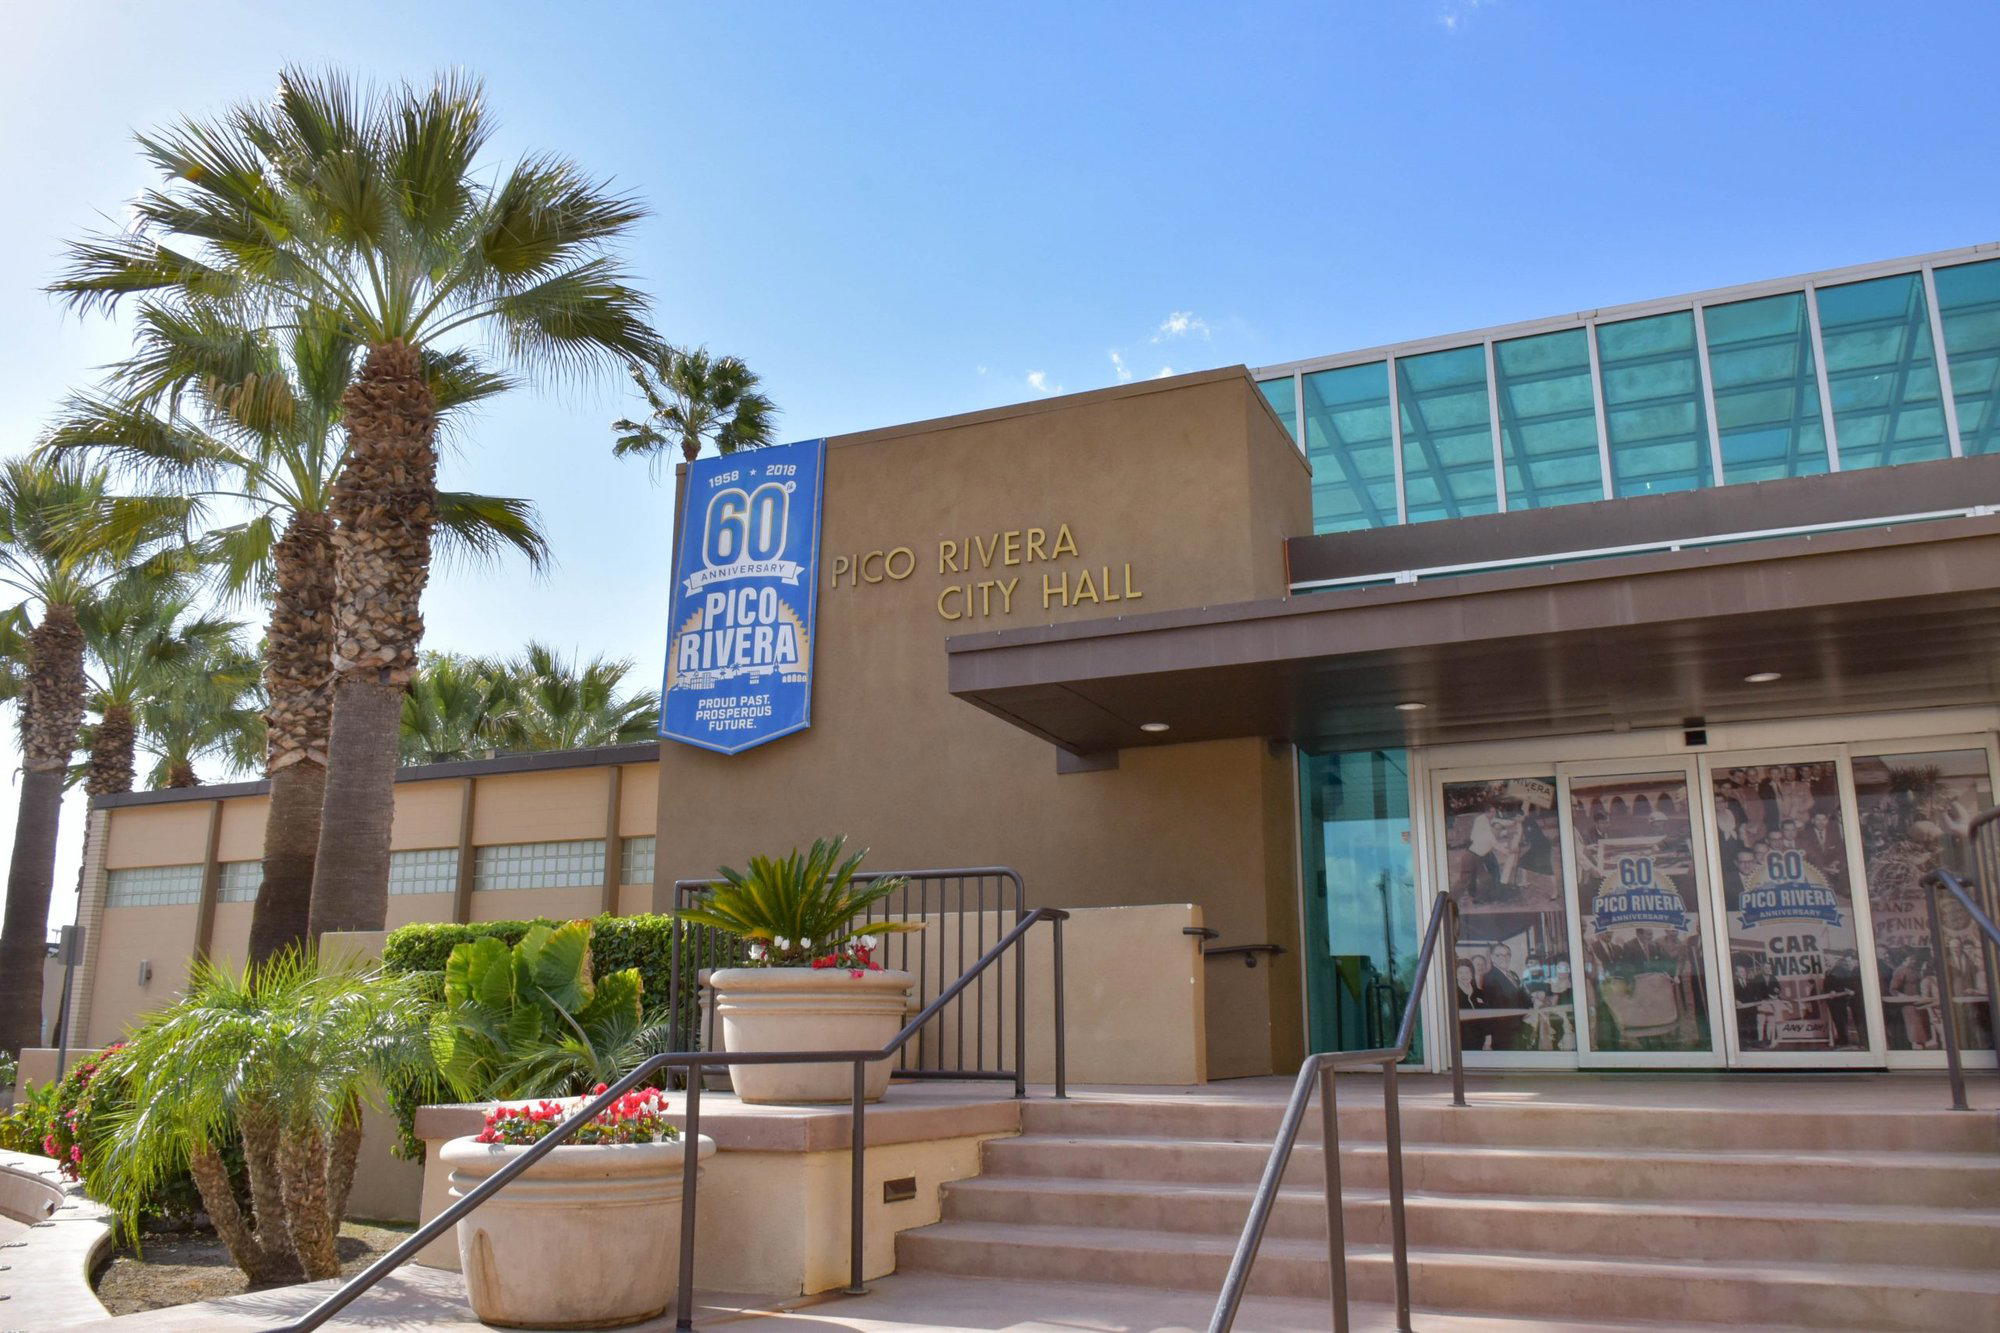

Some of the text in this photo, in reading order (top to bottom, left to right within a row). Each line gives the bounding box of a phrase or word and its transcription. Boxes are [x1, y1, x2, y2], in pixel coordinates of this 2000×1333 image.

[709, 464, 797, 488] 1958 2018
[831, 523, 1079, 588] PICO RIVERA
[701, 563, 786, 581] ANNIVERSARY
[937, 563, 1143, 620] CITY HALL
[704, 586, 778, 630] PICO
[679, 624, 796, 671] RIVERA
[698, 694, 771, 709] PROUD PAST.
[695, 706, 772, 721] PROSPEROUS
[708, 719, 757, 731] FUTURE.
[1595, 895, 1684, 913] PICO RIVERA
[1742, 890, 1836, 909] PICO RIVERA
[1611, 914, 1670, 922] ANNIVERSARY
[1760, 909, 1821, 918] ANNIVERSARY
[1769, 934, 1819, 953] CAR
[1768, 955, 1823, 976] WASH
